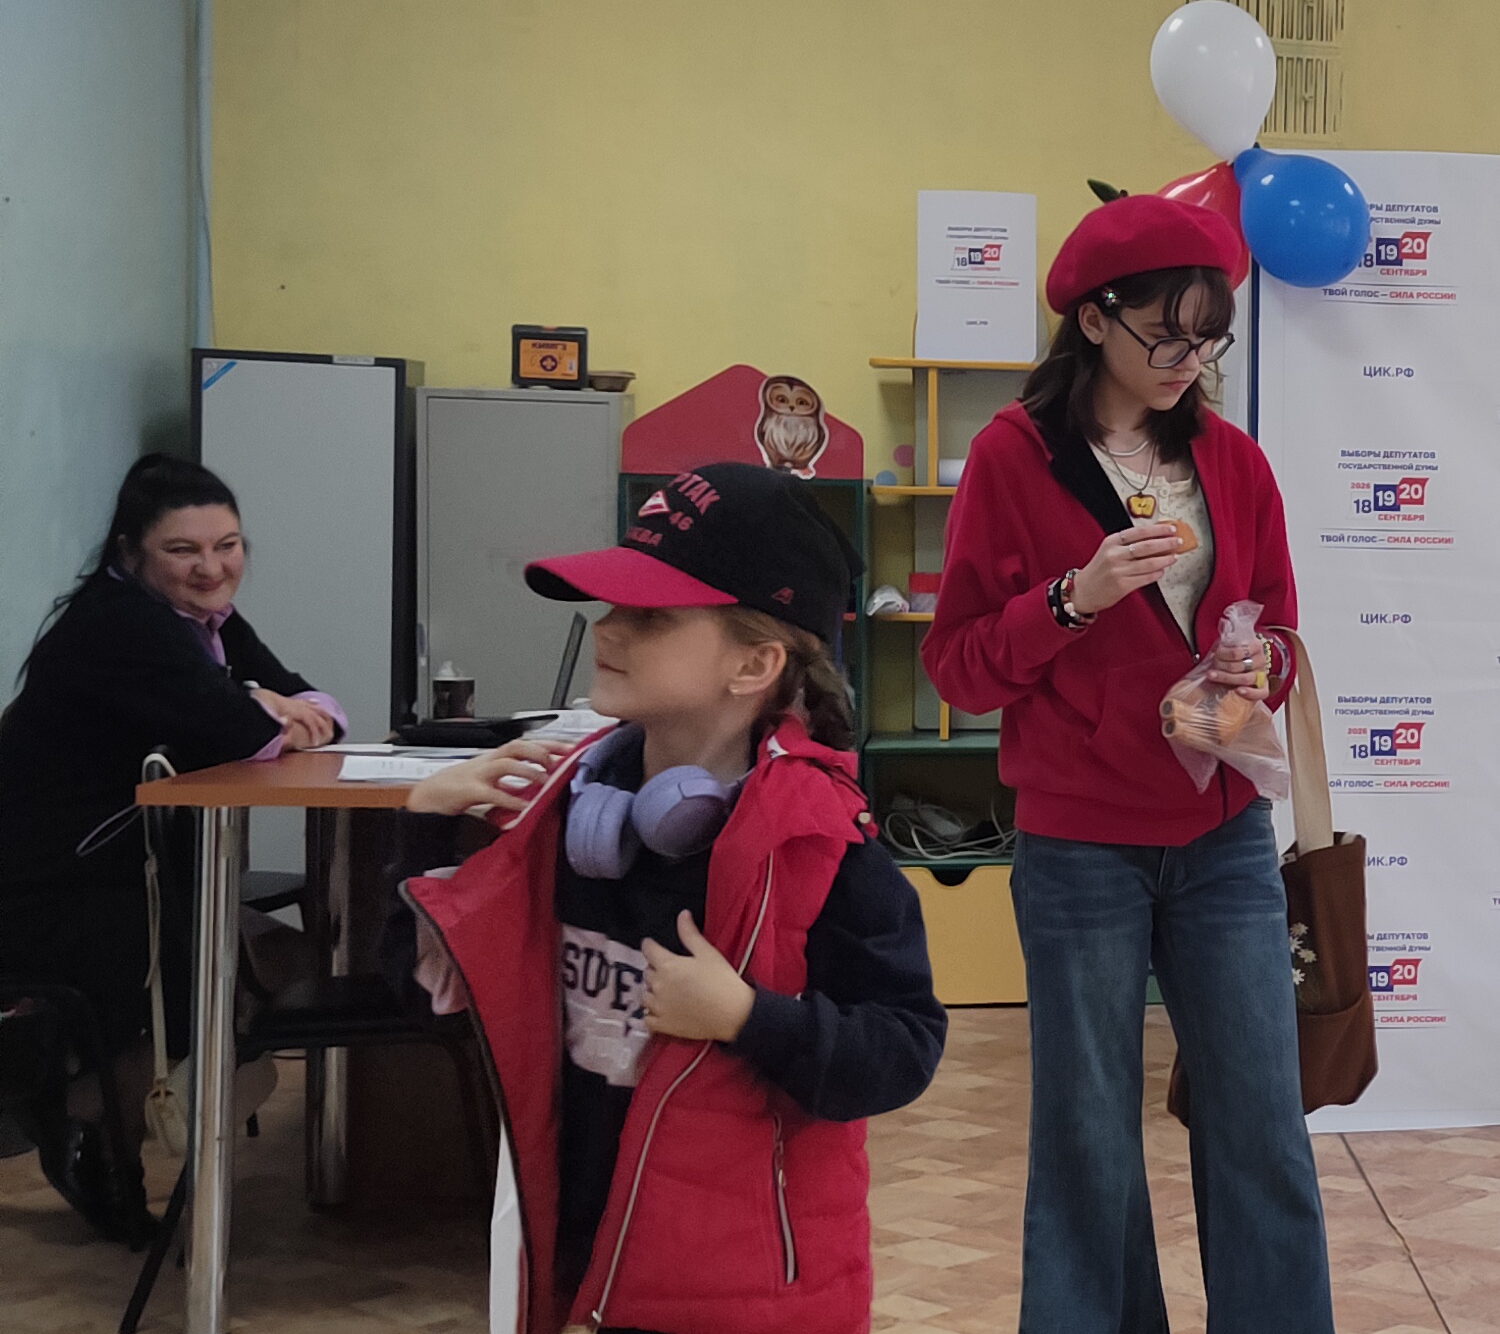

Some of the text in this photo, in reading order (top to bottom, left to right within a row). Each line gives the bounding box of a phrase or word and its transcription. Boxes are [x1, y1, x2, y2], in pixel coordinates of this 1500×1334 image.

[1385, 204, 1438, 213] ДЕПУТАТОВ
[984, 248, 998, 257] 20
[1378, 238, 1424, 260] 19 20
[1322, 288, 1347, 296] ТВОЙ
[1363, 366, 1414, 378] ЦИК.РФ
[1341, 450, 1435, 459] ВЫБОРЫ ДЕПУТАТОВ
[1338, 462, 1413, 470] ГОСУДАРСТВЕННОЙ
[1354, 484, 1422, 514] 18 19 20
[1320, 534, 1344, 542] ТВОЙ
[1361, 613, 1411, 624] ЦИК.РФ
[1338, 696, 1432, 705] ВЫБОРЫ ДЕПУТАТОВ
[1335, 708, 1410, 716] ГОСУДАРСТВЕННОЙ
[1350, 728, 1419, 759] 18 19 20
[1329, 779, 1342, 787] ОЙ
[1367, 856, 1408, 867] ИК.РФ
[1370, 965, 1415, 987] 19 20
